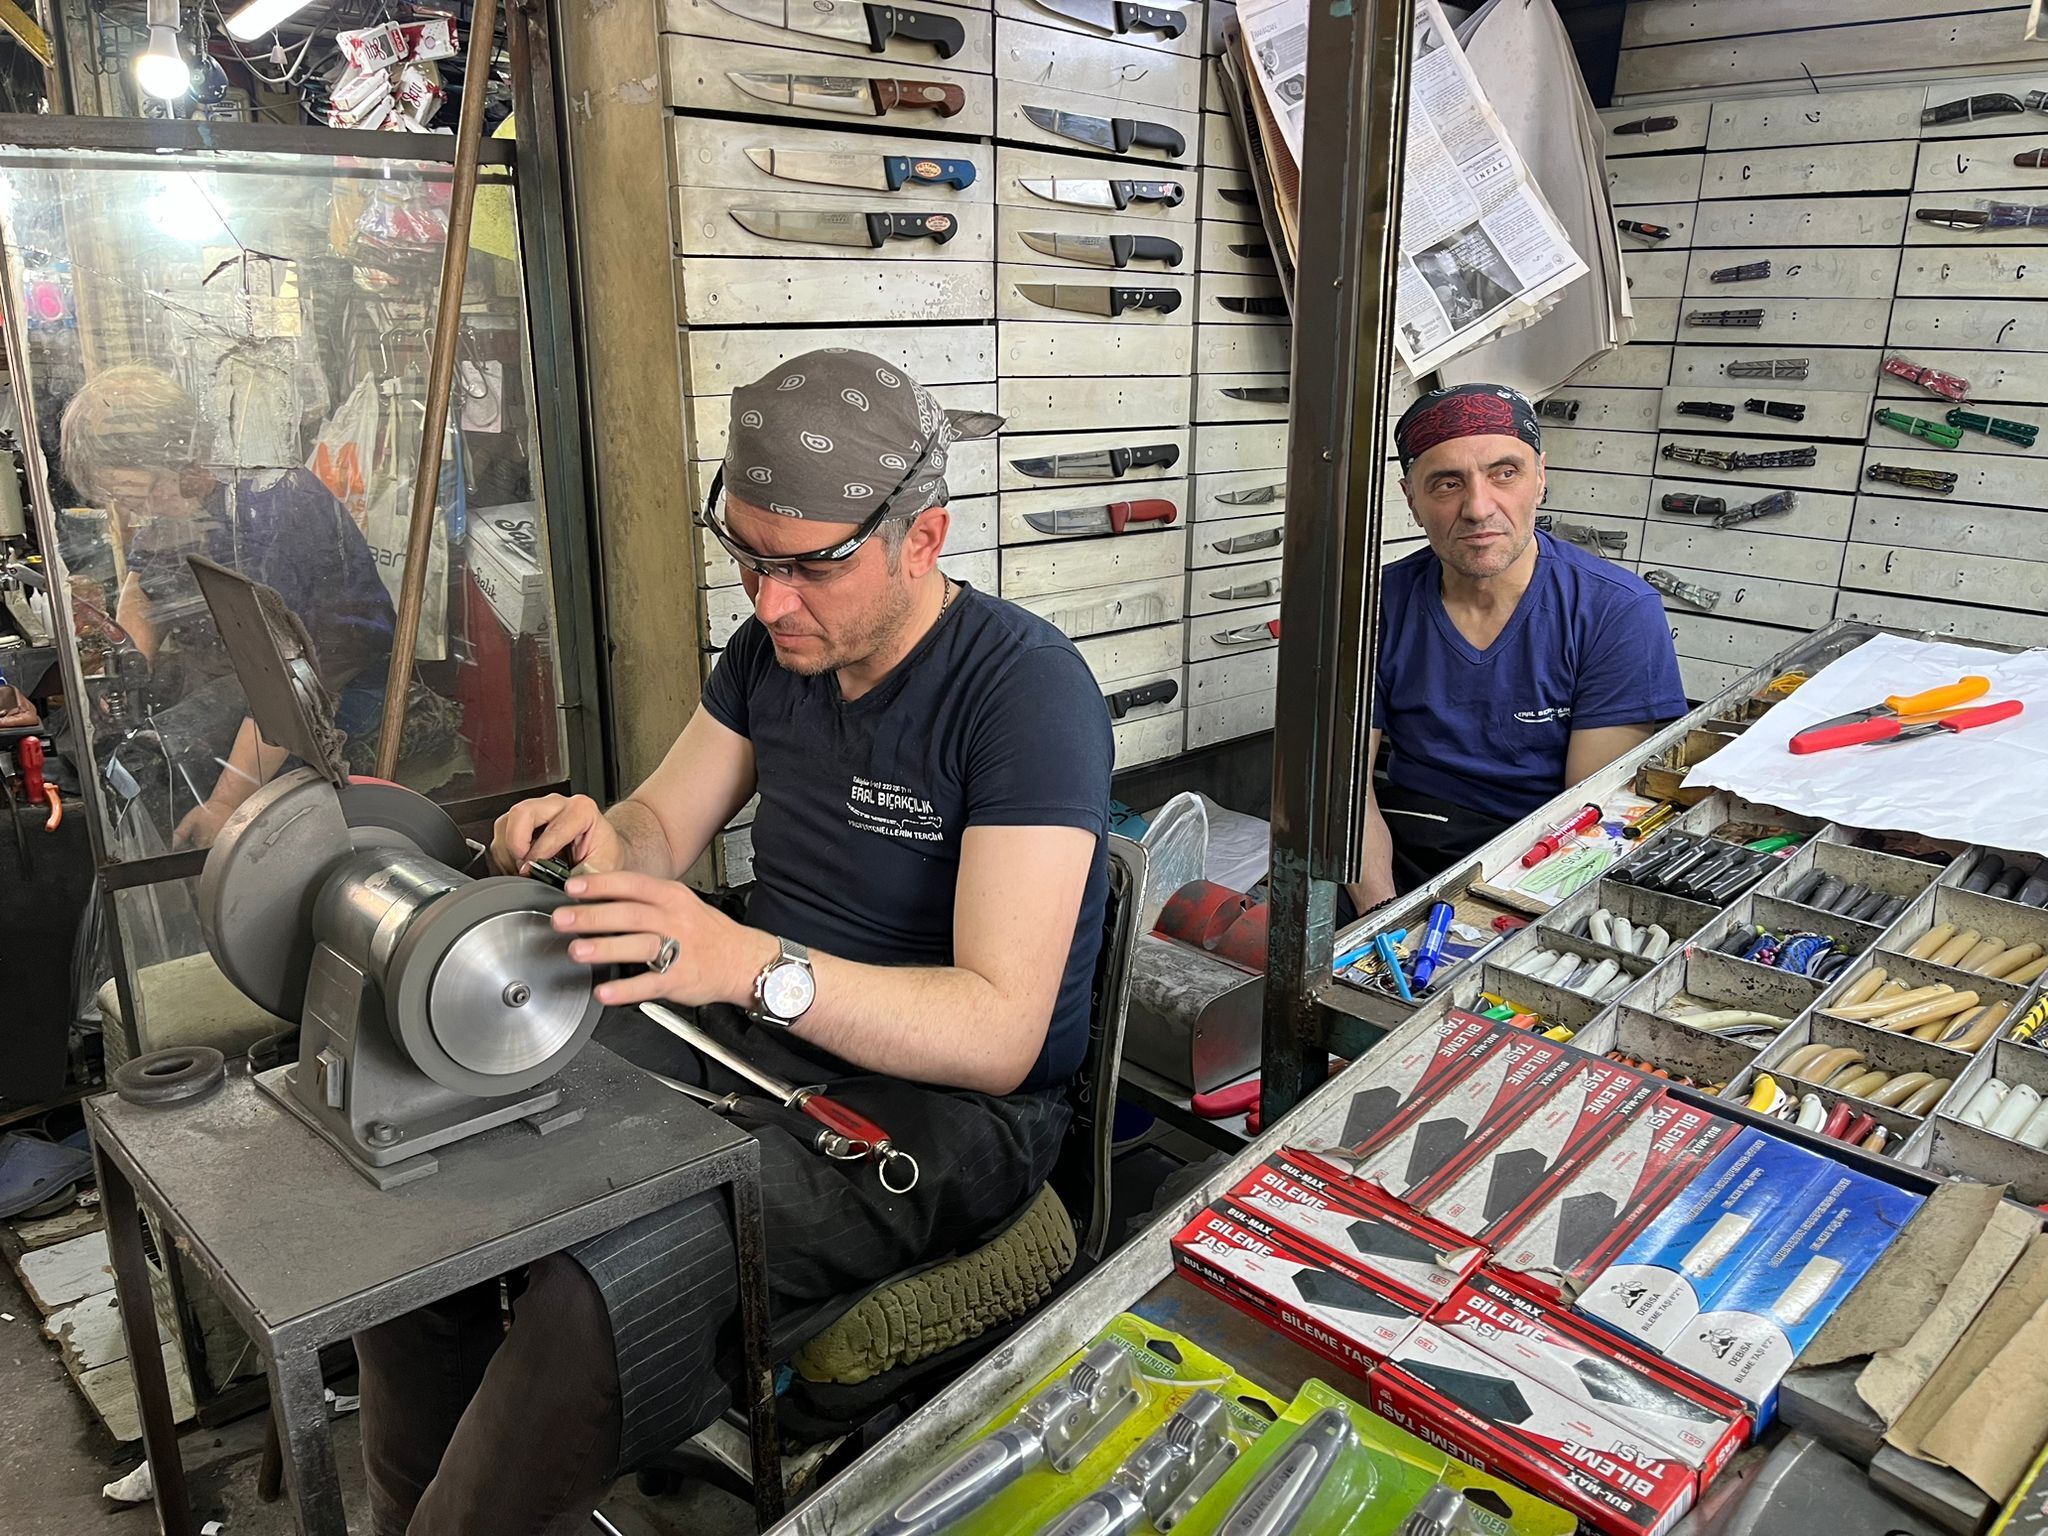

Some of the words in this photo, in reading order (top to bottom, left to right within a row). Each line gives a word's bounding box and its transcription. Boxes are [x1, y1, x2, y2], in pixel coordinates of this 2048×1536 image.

[877, 791, 934, 814] BIÇAKÇILIK
[1439, 1024, 1483, 1058] BİLEME
[1470, 1033, 1500, 1058] BUL-MAX
[1506, 1050, 1552, 1086] BİLEME
[1539, 1061, 1570, 1087] BUL-MAX
[1585, 1075, 1632, 1115] BİLEME
[1619, 1087, 1651, 1115] BUL-MAX
[1652, 1112, 1700, 1155] BİLEME
[1689, 1126, 1722, 1156] BUL-MAX
[1261, 1172, 1328, 1212] BİLEME
[1280, 1163, 1328, 1190] BUL-MAX
[1207, 1218, 1275, 1259] BİLEME
[1227, 1208, 1276, 1235] BUL-MAX
[1183, 1256, 1227, 1285] BUL-MAX
[1487, 1284, 1545, 1317] BUL-MAX
[1281, 1311, 1339, 1350] BİLEME
[1454, 1308, 1504, 1341] TAŞI
[1466, 1295, 1549, 1344] BİLEME
[1109, 1333, 1136, 1353] KNIFE
[1134, 1348, 1176, 1378] GRINDER
[1420, 1427, 1486, 1472] BİLEME
[1610, 1440, 1666, 1480] TAŞI
[1559, 1438, 1656, 1498] BİLEME
[1567, 1470, 1633, 1513] BUL-MAX
